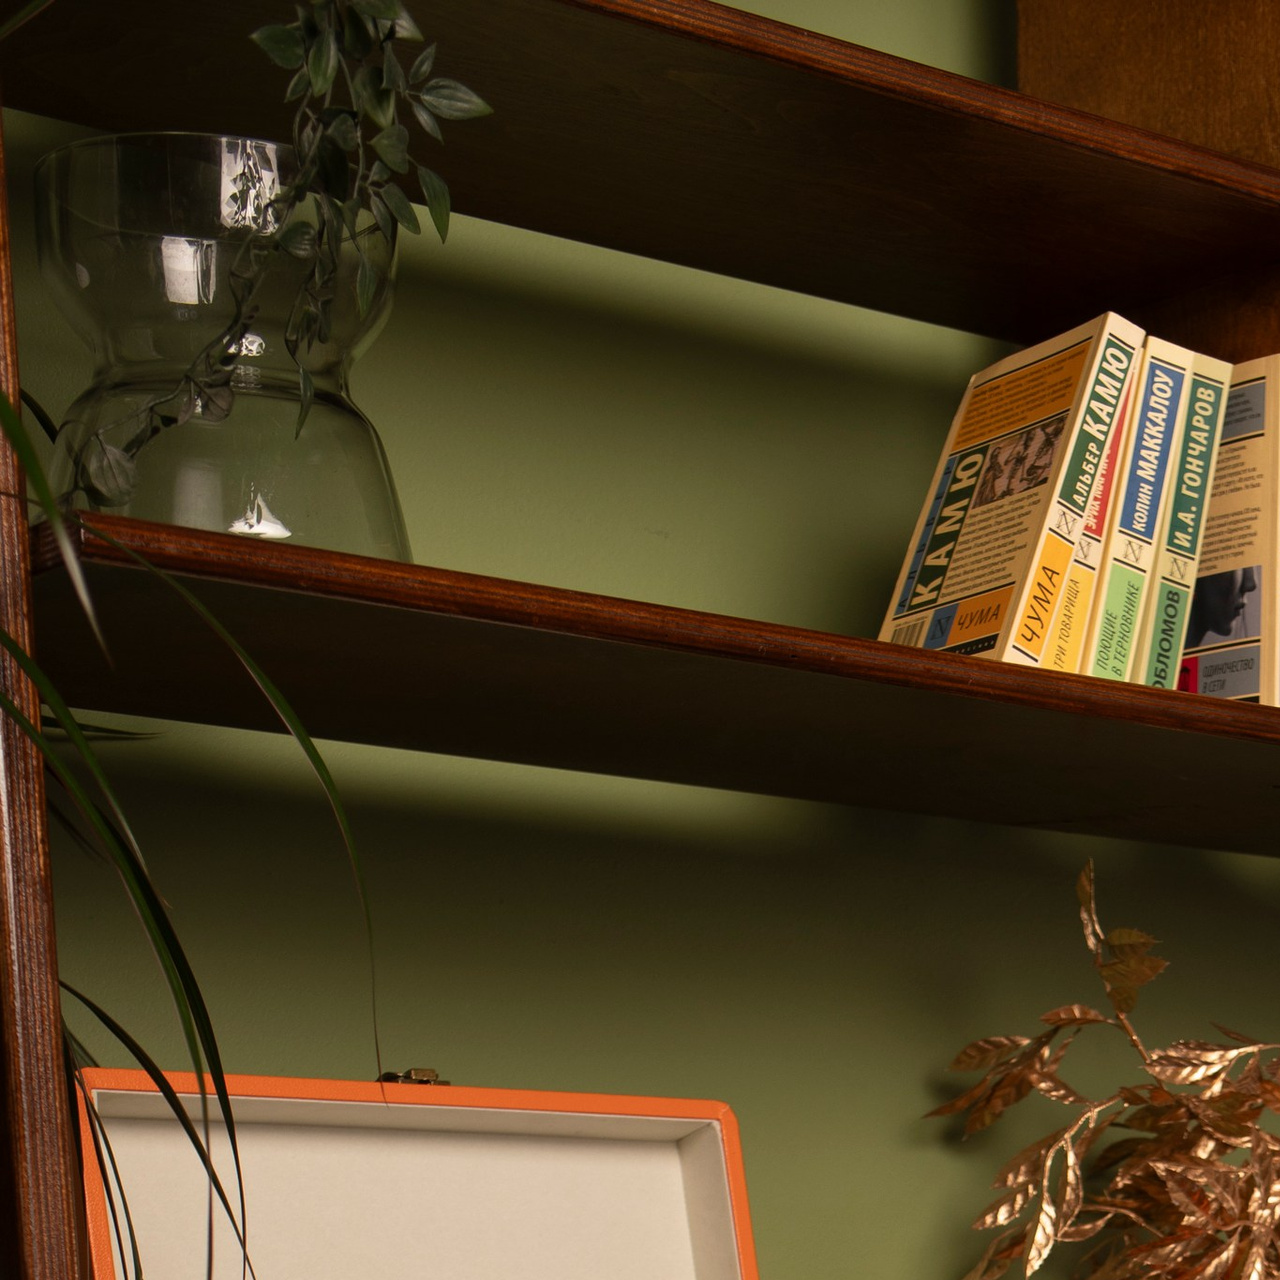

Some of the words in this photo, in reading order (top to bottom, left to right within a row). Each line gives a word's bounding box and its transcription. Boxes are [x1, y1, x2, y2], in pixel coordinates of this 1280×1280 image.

[1082, 347, 1129, 442] КАМЮ
[1136, 369, 1174, 482] МАККАЛОУ
[1073, 442, 1101, 507] АЛЬБЕР
[1180, 387, 1216, 499] ГОНЧАРОВ
[910, 452, 984, 607] КАМЮ
[1132, 483, 1154, 532] КОЛИН
[957, 603, 1001, 631] ЧУМА
[1021, 565, 1060, 643] ЧУМА
[1059, 578, 1080, 644] ТОВАРИЩА
[1096, 608, 1119, 671] ПОЮЩИЕ
[1114, 580, 1141, 665] ТЕРНОВНИКЕ
[1152, 590, 1181, 689] ОБЛОМОВ
[1053, 645, 1067, 669] ТРИ
[1111, 667, 1123, 677] В
